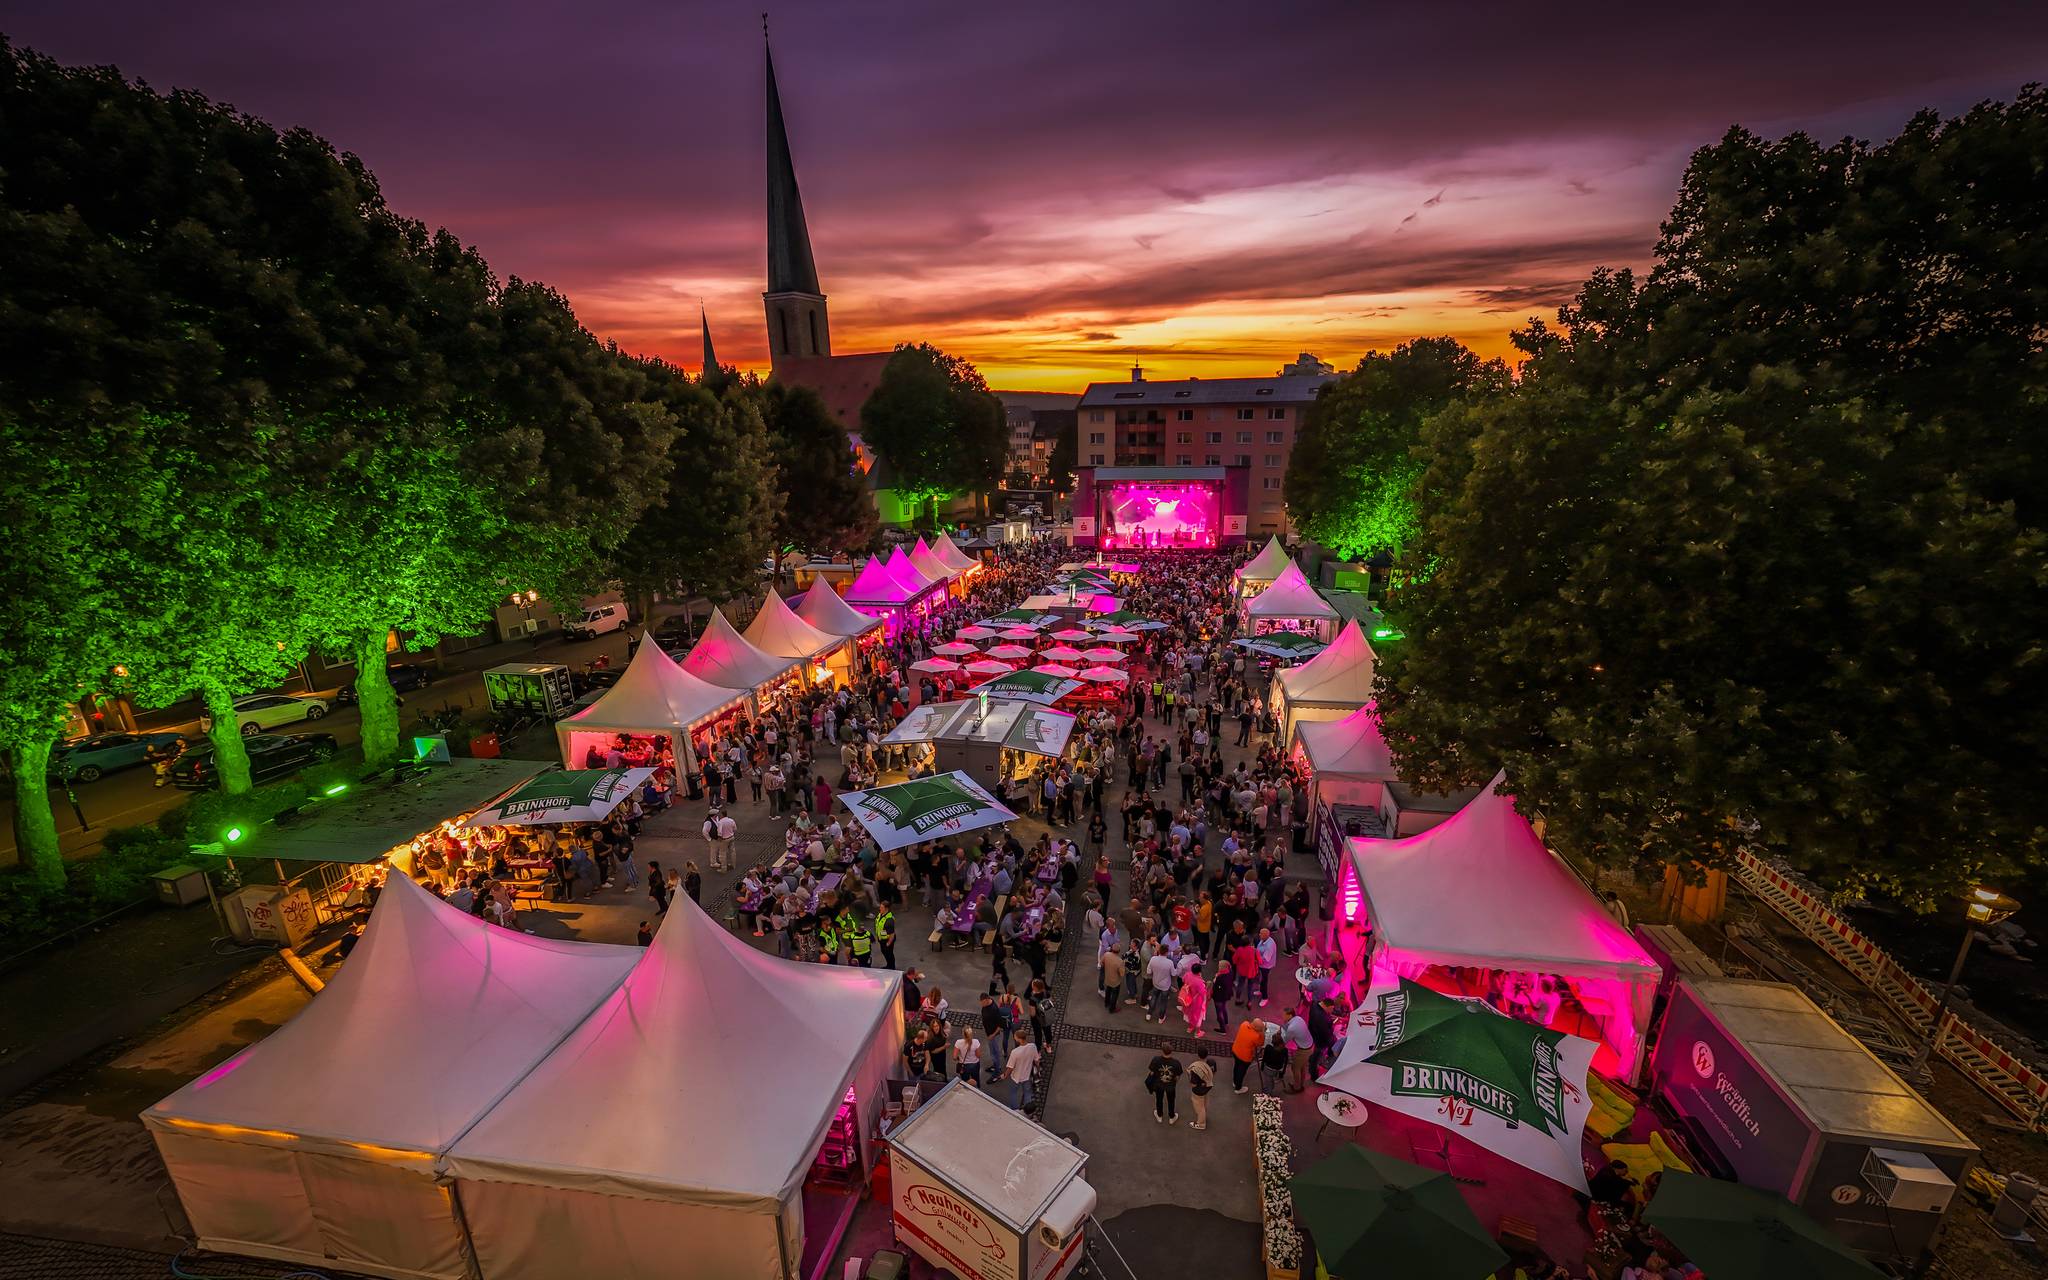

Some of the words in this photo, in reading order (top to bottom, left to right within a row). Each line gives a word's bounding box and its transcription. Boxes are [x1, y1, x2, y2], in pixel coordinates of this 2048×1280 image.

[1715, 1080, 1760, 1137] Weidlich
[917, 1189, 979, 1229] Neuhaus
[931, 1206, 969, 1231] Grillwurst
[923, 1235, 985, 1280] die-grillwurst.d
